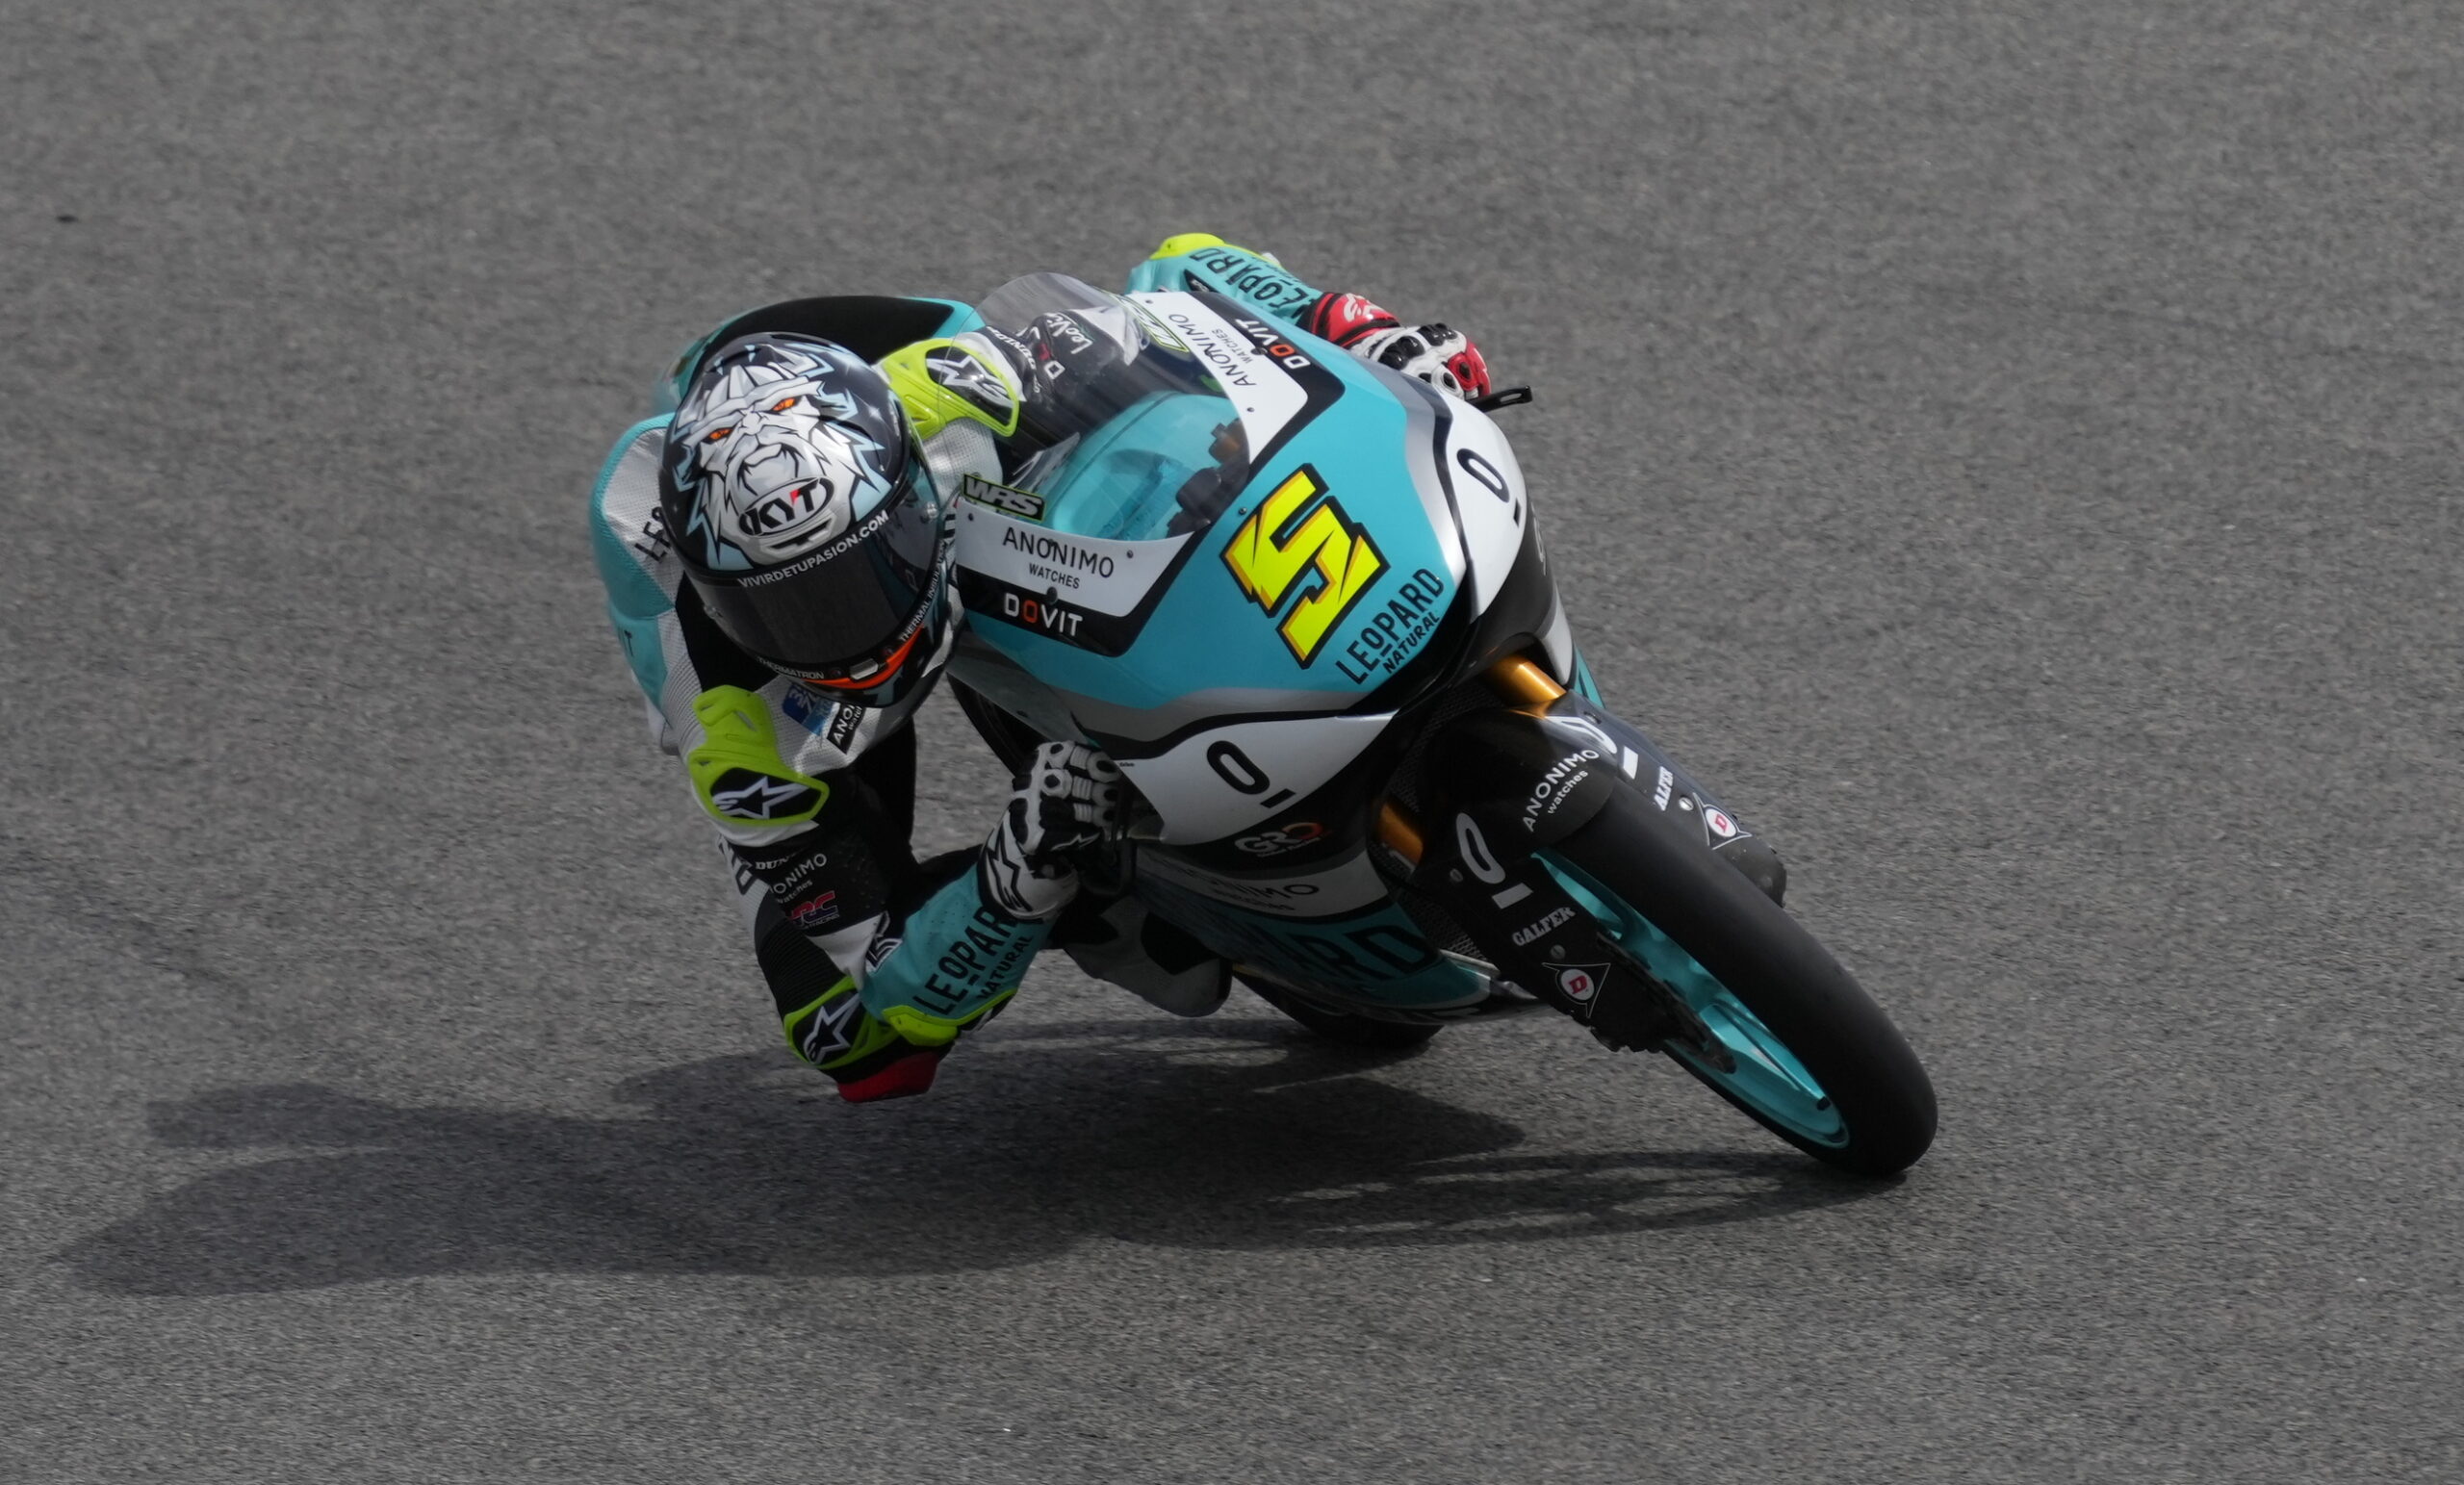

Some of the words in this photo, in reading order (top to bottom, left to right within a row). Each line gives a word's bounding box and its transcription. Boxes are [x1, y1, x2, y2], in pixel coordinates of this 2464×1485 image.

[1168, 313, 1258, 387] ANONIMO
[1211, 328, 1253, 365] WATCHES
[1235, 318, 1311, 370] DOVIT
[742, 478, 819, 537] KYT
[737, 509, 890, 588] VIVIRDETUPASION.COM
[1002, 526, 1115, 579] ANONIMO
[1028, 562, 1081, 590] WATCHES
[1220, 464, 1390, 669] 5
[1004, 592, 1084, 637] DOVIT
[1335, 568, 1445, 685] LEOPARD
[1382, 611, 1441, 675] NATURAL
[1522, 748, 1601, 832] ANONIMO
[1547, 769, 1589, 815] watches
[1512, 906, 1577, 947] GALFER
[976, 935, 1034, 1000] NATURAL
